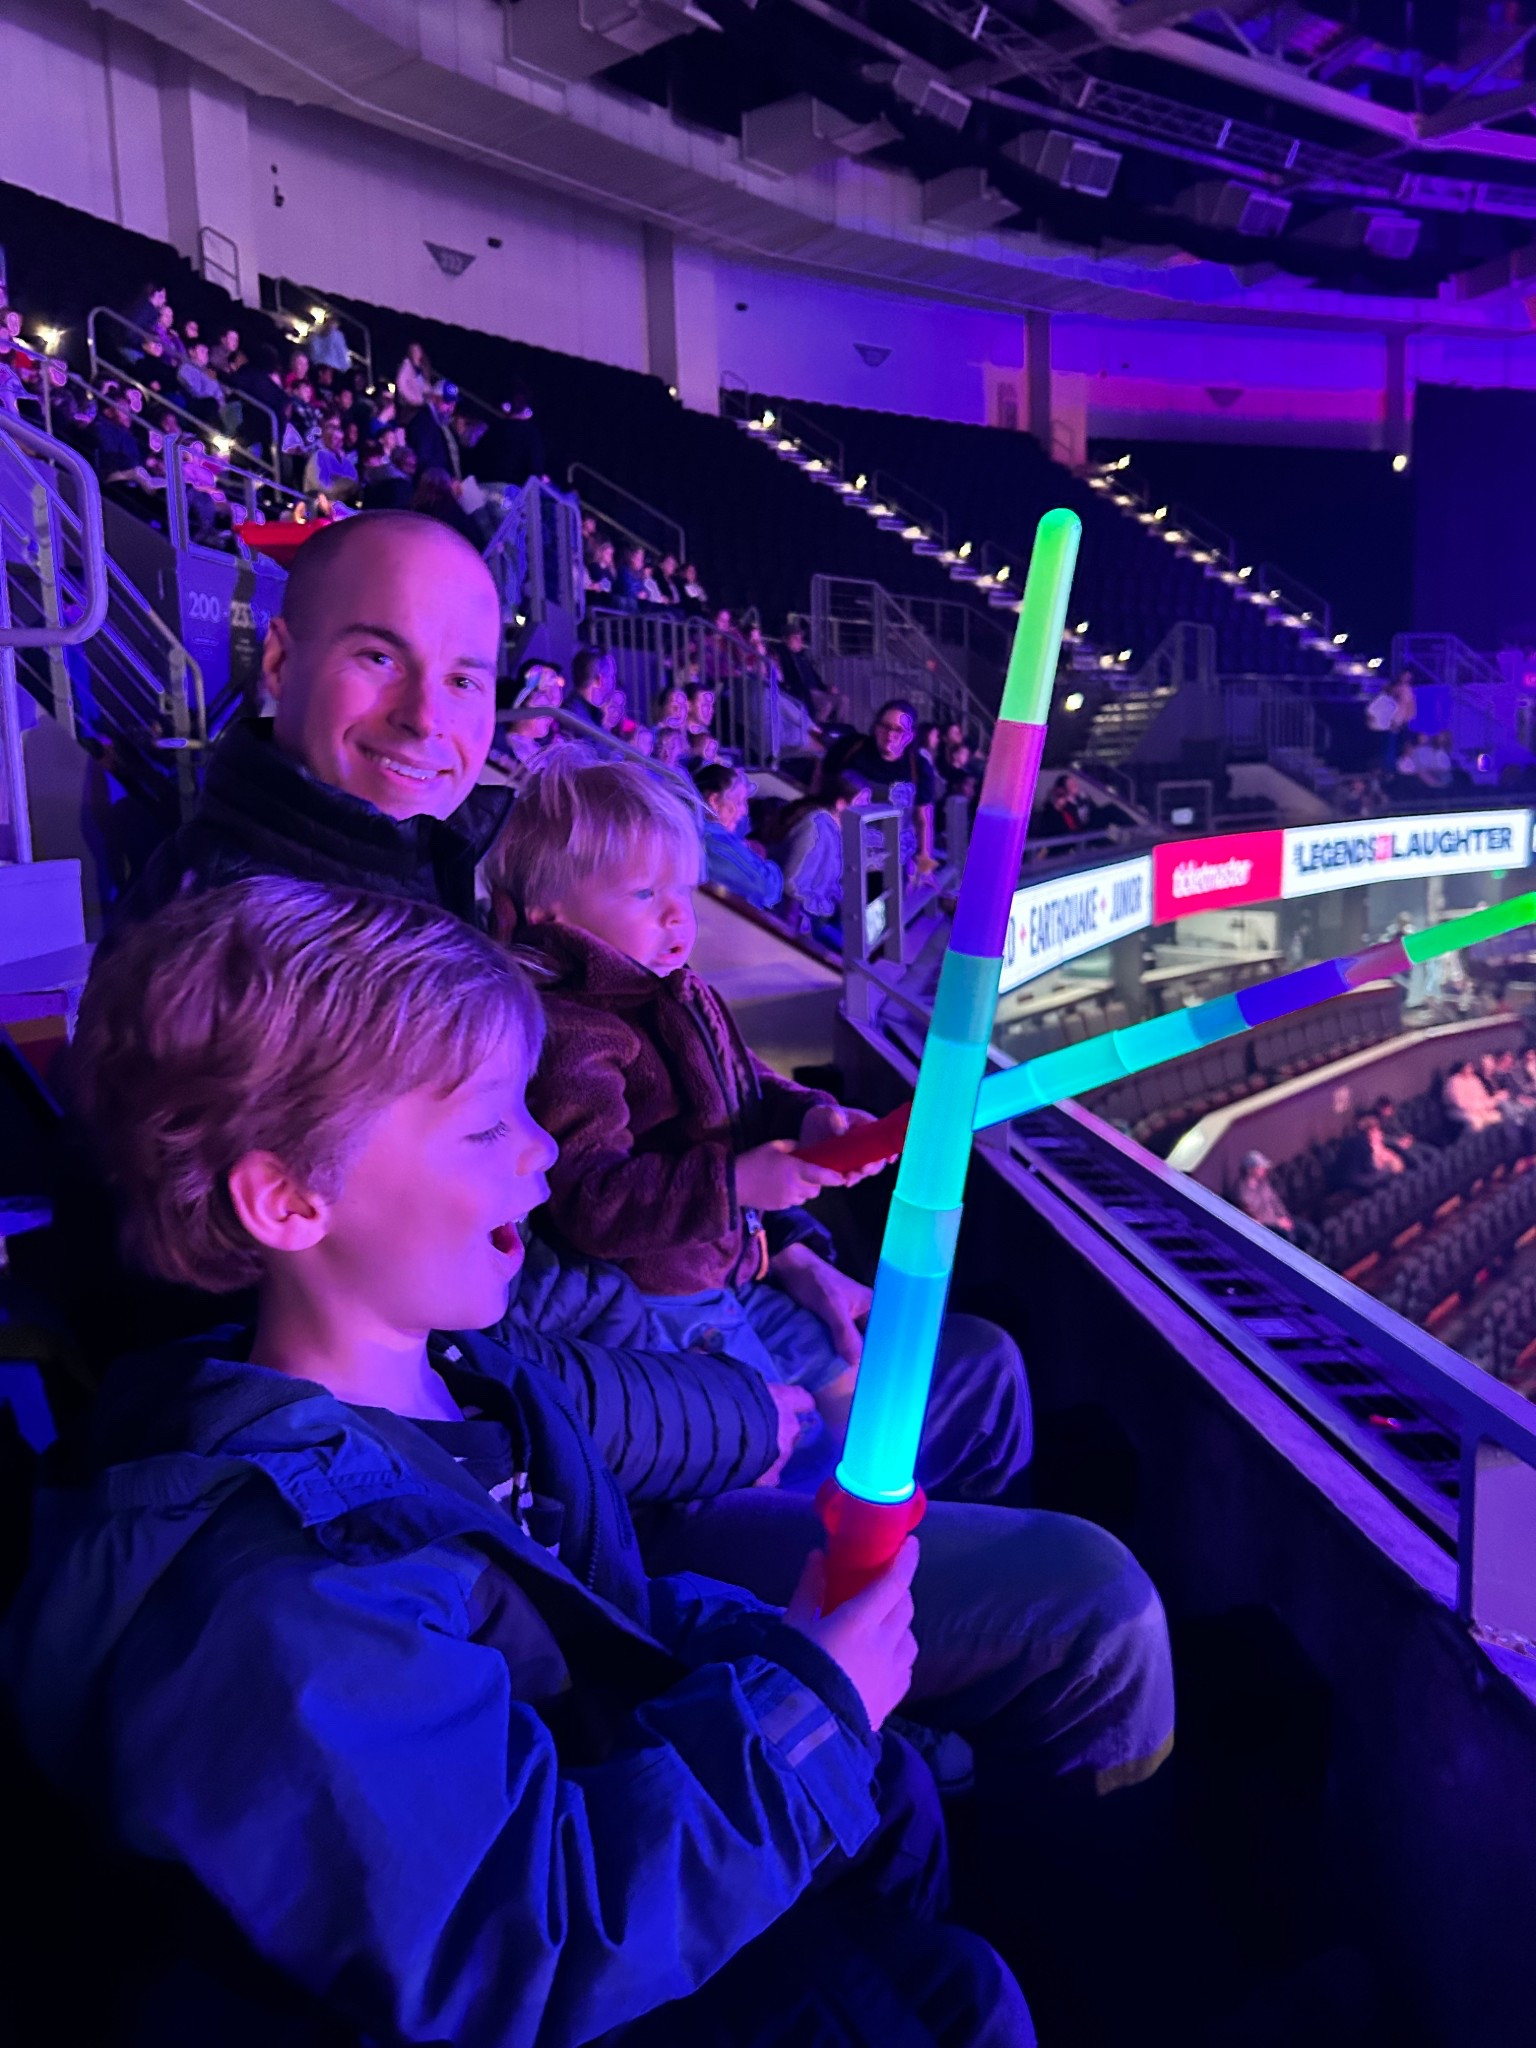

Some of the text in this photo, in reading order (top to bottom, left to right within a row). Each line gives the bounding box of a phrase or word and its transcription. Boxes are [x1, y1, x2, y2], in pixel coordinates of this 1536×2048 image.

[188, 591, 220, 623] 200
[1299, 835, 1377, 873] LEGENDS
[1391, 826, 1512, 858] LAUGHTER
[1030, 886, 1098, 957] EARTHQUAKE
